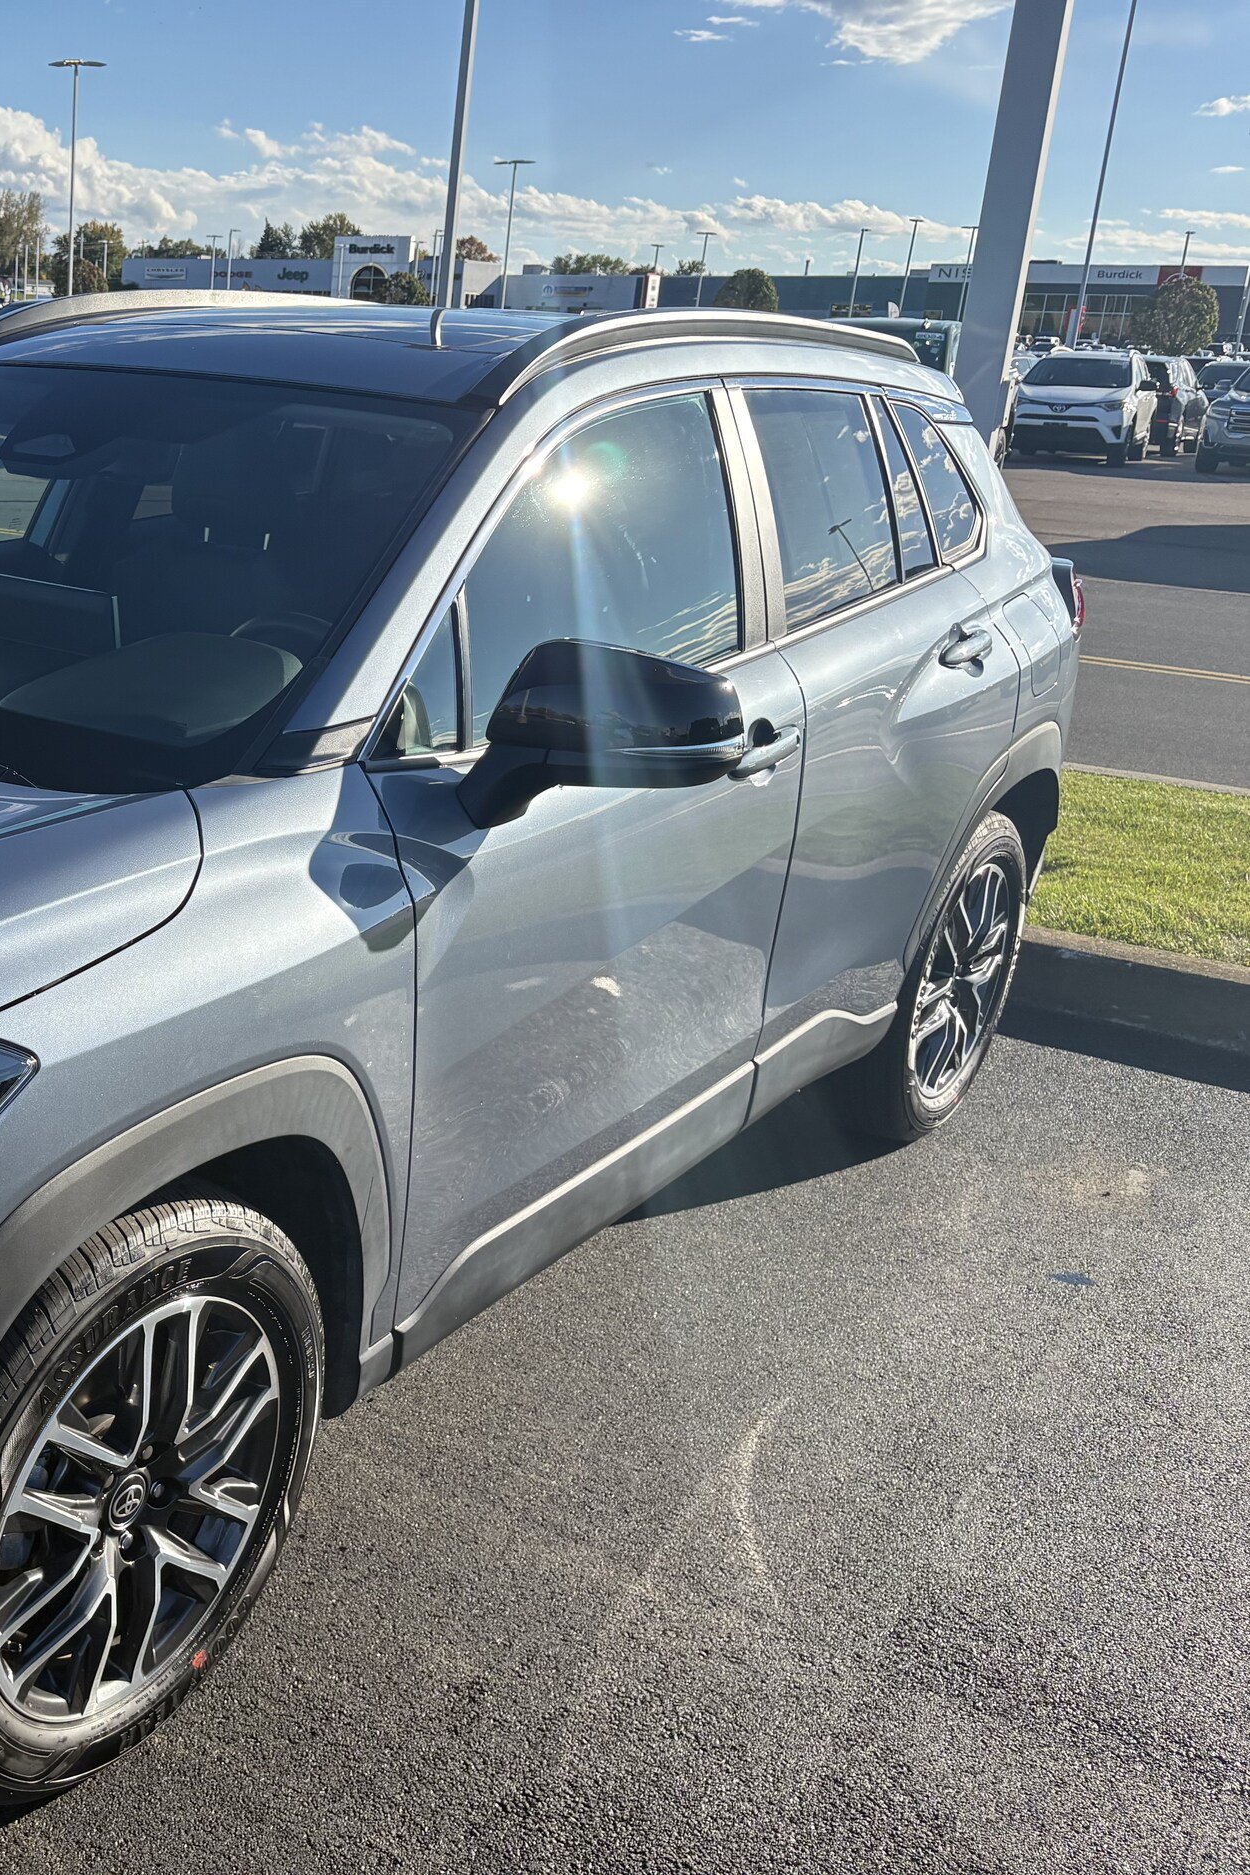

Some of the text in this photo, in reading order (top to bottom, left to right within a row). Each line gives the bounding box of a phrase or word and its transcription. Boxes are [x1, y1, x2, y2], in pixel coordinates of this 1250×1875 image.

[349, 243, 395, 254] Burdick
[277, 267, 309, 282] Jeep
[1097, 270, 1142, 279] Burdick
[38, 1257, 192, 1416] ASSURANCE
